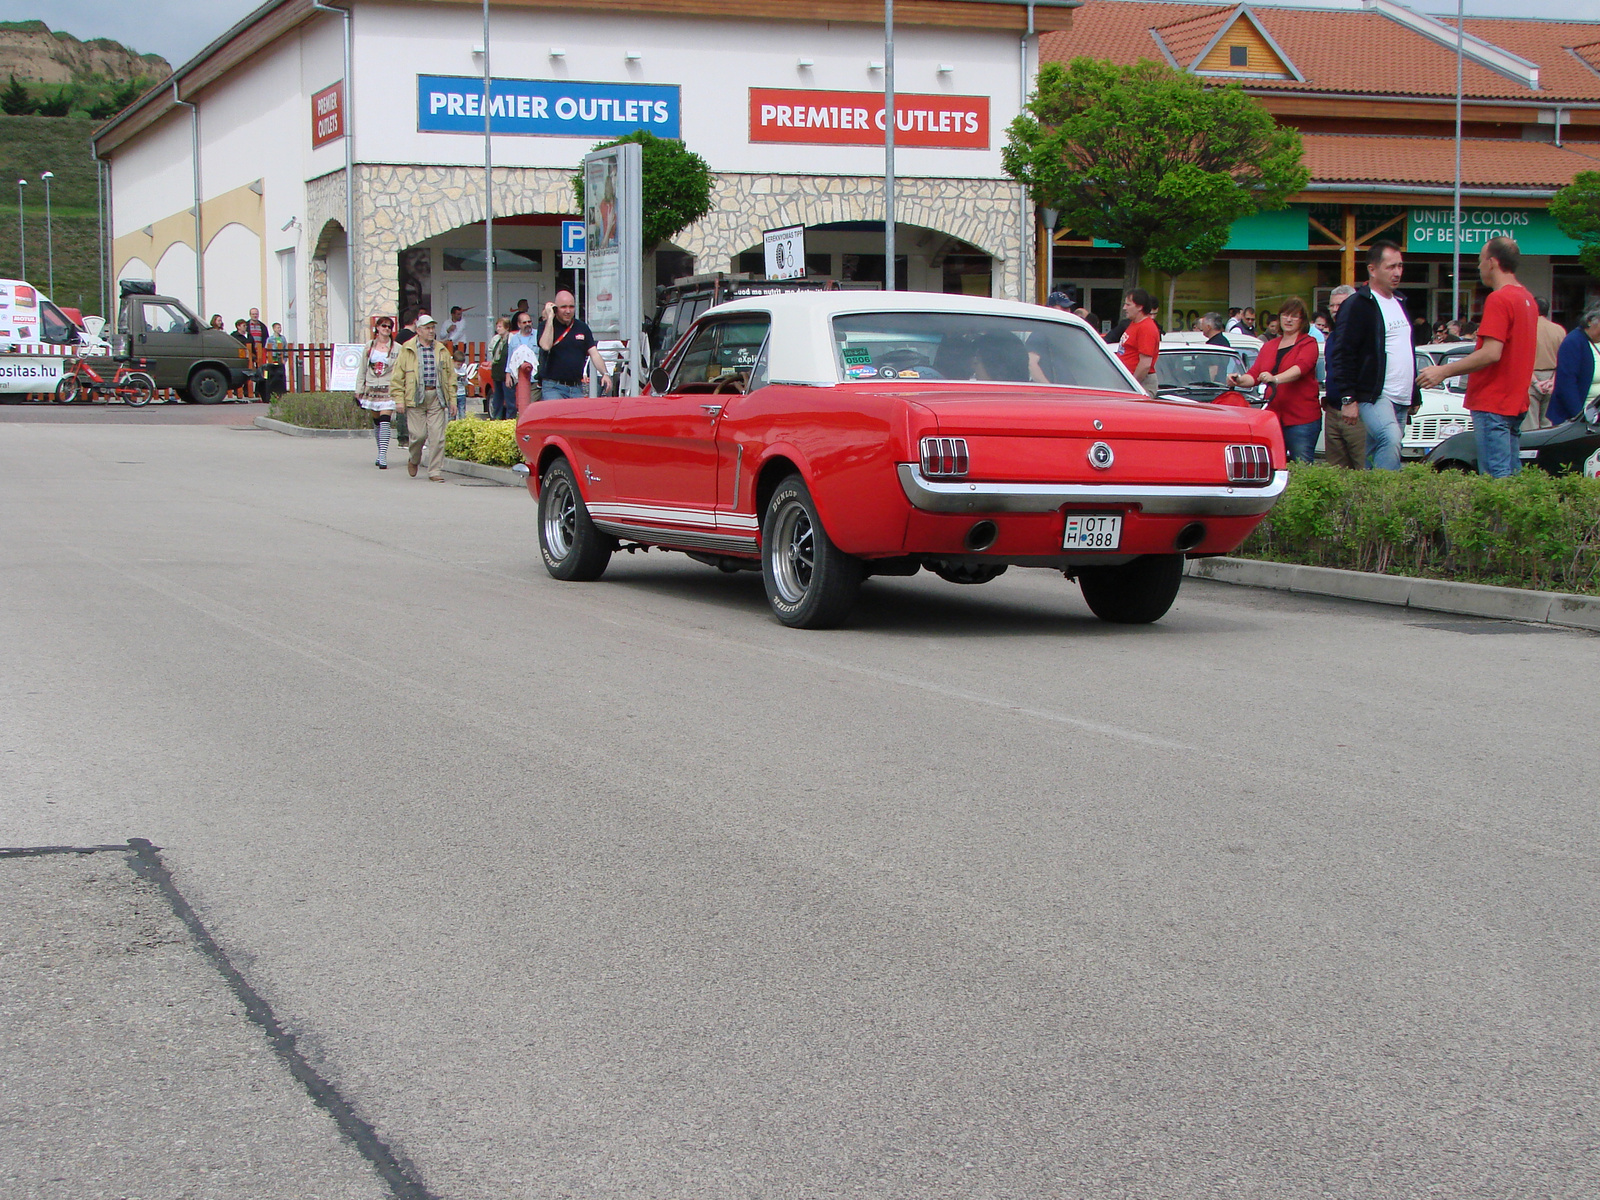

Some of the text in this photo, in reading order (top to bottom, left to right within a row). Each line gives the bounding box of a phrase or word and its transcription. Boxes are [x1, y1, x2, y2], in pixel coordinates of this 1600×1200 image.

[555, 97, 669, 124] OUTLETS
[874, 108, 979, 134] OUTLETS
[318, 113, 338, 138] OUTLETS
[1413, 210, 1529, 225] UNITED COLORS
[568, 225, 586, 248] P
[1413, 227, 1434, 242] OF
[772, 490, 798, 512] DUNLOP
[1067, 533, 1077, 543] H
[1086, 533, 1113, 547] 388
